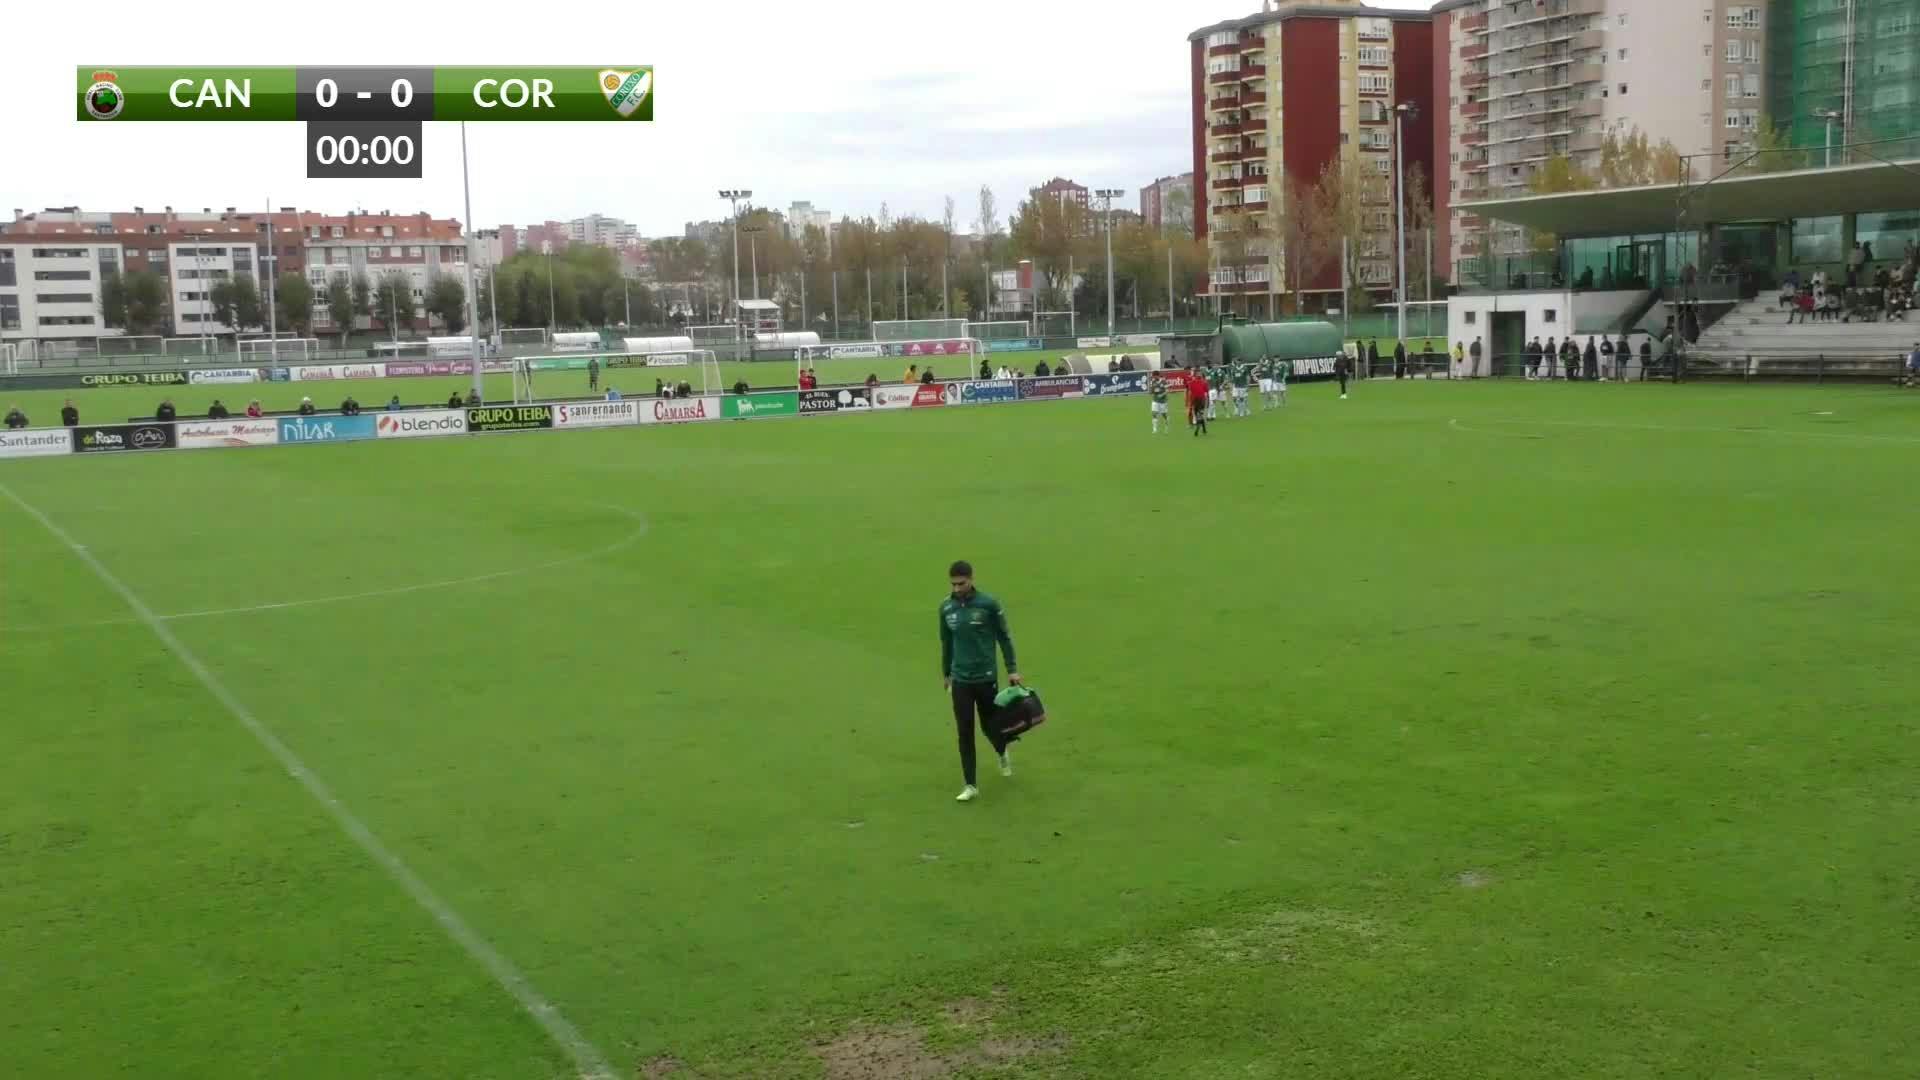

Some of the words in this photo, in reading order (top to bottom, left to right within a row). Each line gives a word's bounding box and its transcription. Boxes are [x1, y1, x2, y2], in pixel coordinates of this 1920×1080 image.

[81, 375, 138, 385] GRUPO
[144, 372, 185, 383] TEIBA
[654, 400, 705, 421] CAMARSA
[800, 399, 836, 409] PASTOR
[468, 409, 514, 424] GRUPO
[518, 405, 552, 421] TEIBA
[401, 415, 463, 432] blendio
[0, 433, 67, 447] Santander
